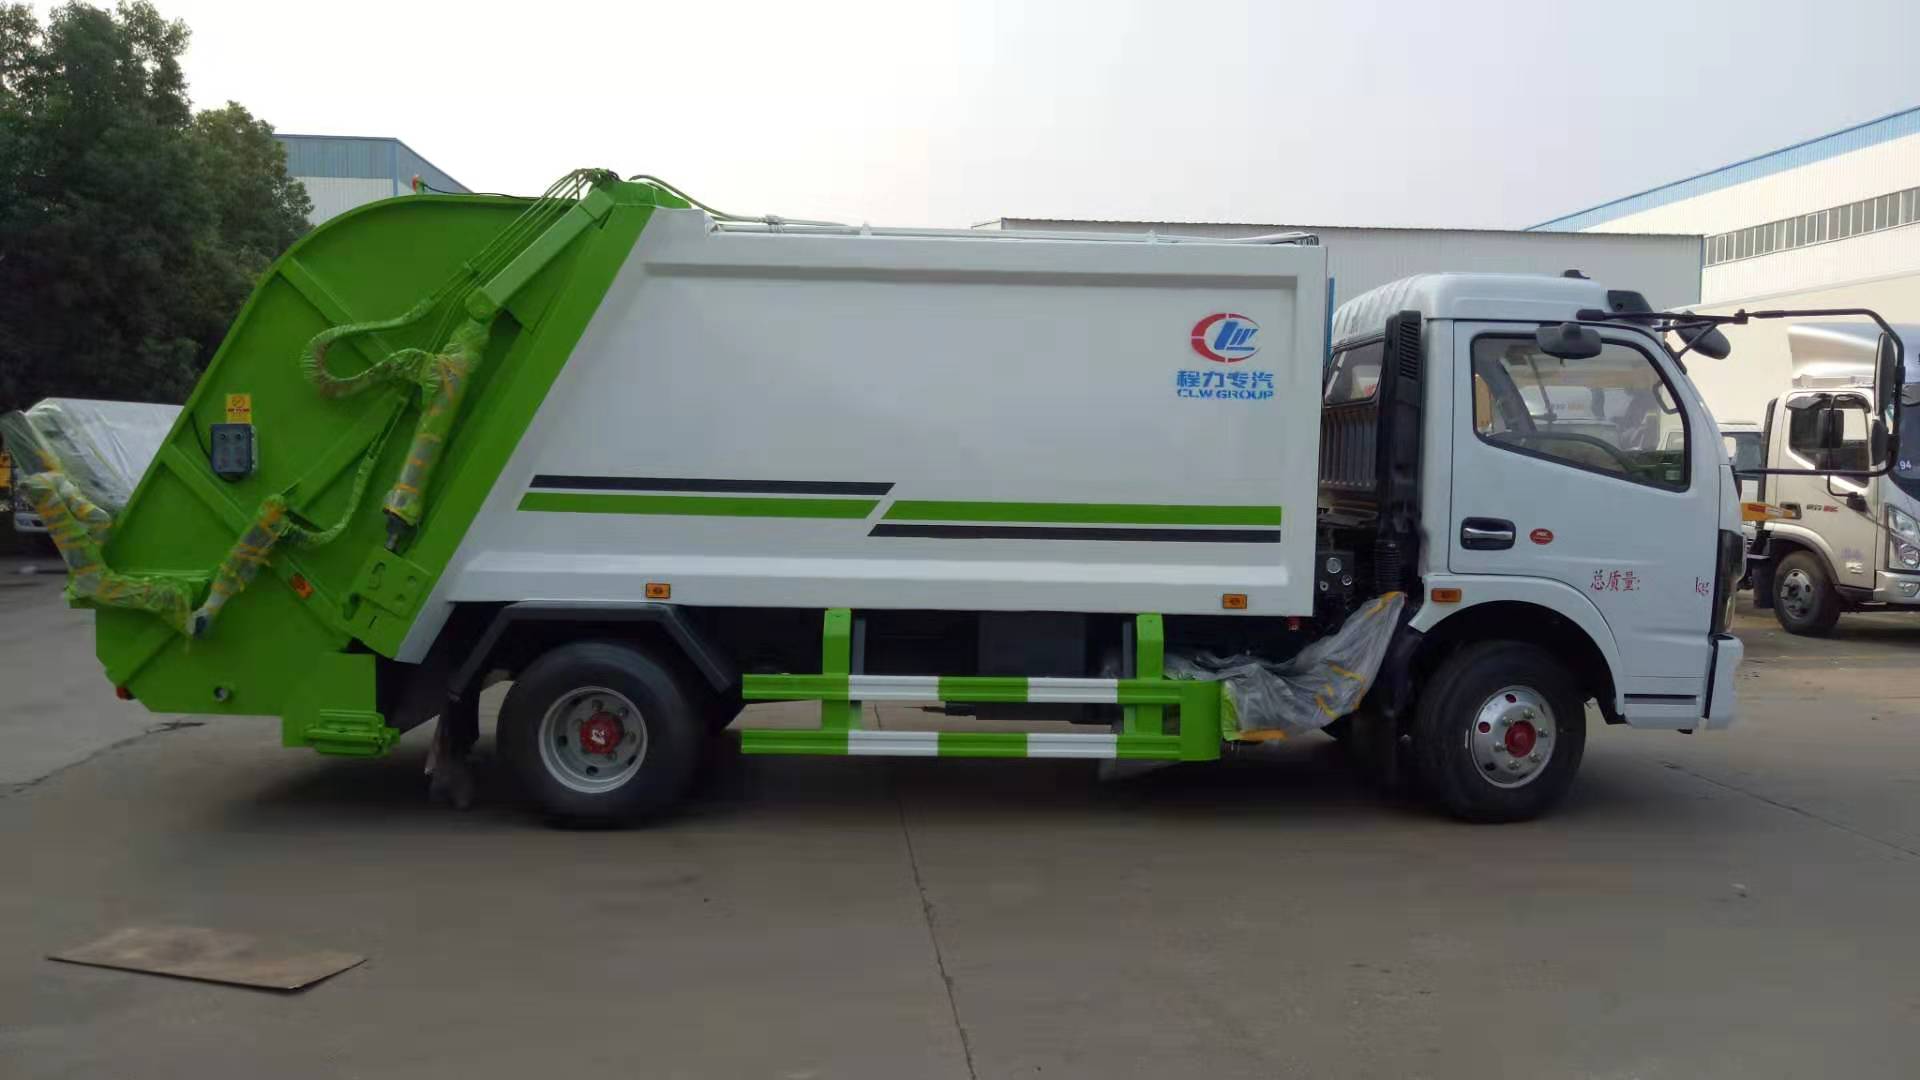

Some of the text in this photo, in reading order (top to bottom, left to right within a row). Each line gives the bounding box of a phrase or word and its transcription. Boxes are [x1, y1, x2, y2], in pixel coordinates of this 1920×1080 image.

[1177, 370, 1275, 389] 程力专汽
[1177, 389, 1275, 401] CLW GROUP
